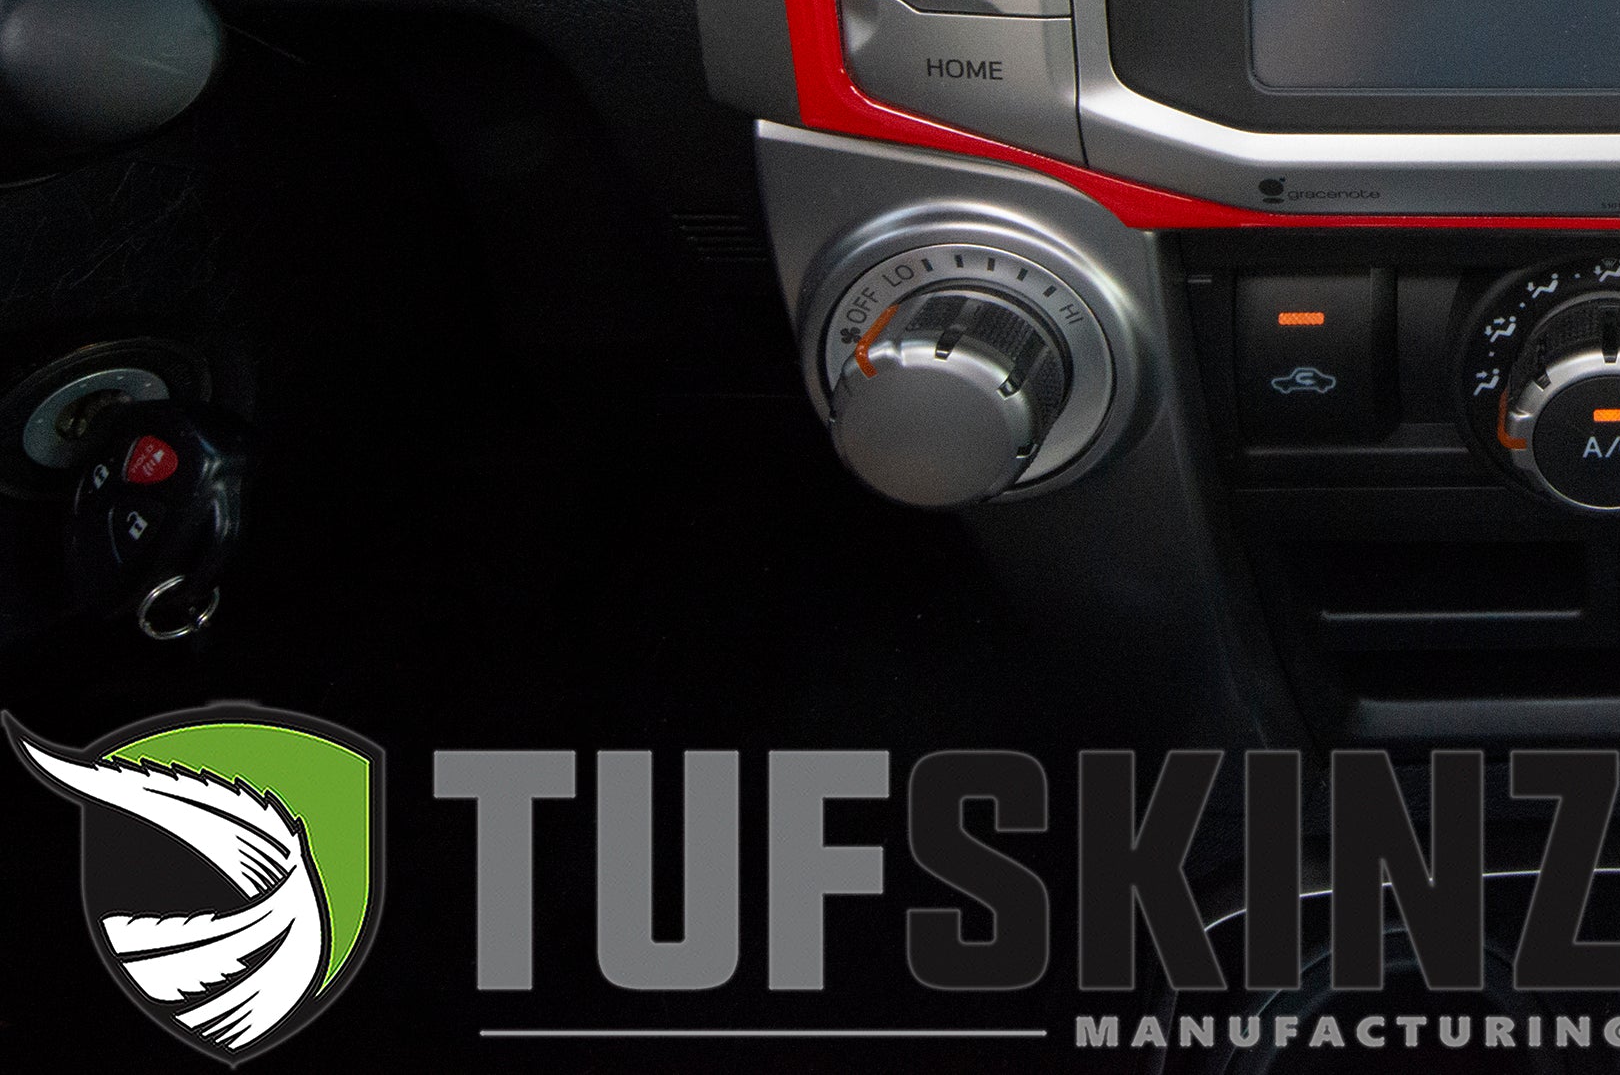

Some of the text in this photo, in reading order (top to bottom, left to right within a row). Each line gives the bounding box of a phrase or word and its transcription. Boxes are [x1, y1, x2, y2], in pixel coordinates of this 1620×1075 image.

[926, 58, 1004, 81] HOME
[1287, 190, 1380, 201] gracenote
[846, 264, 1085, 327] OFF LO HI
